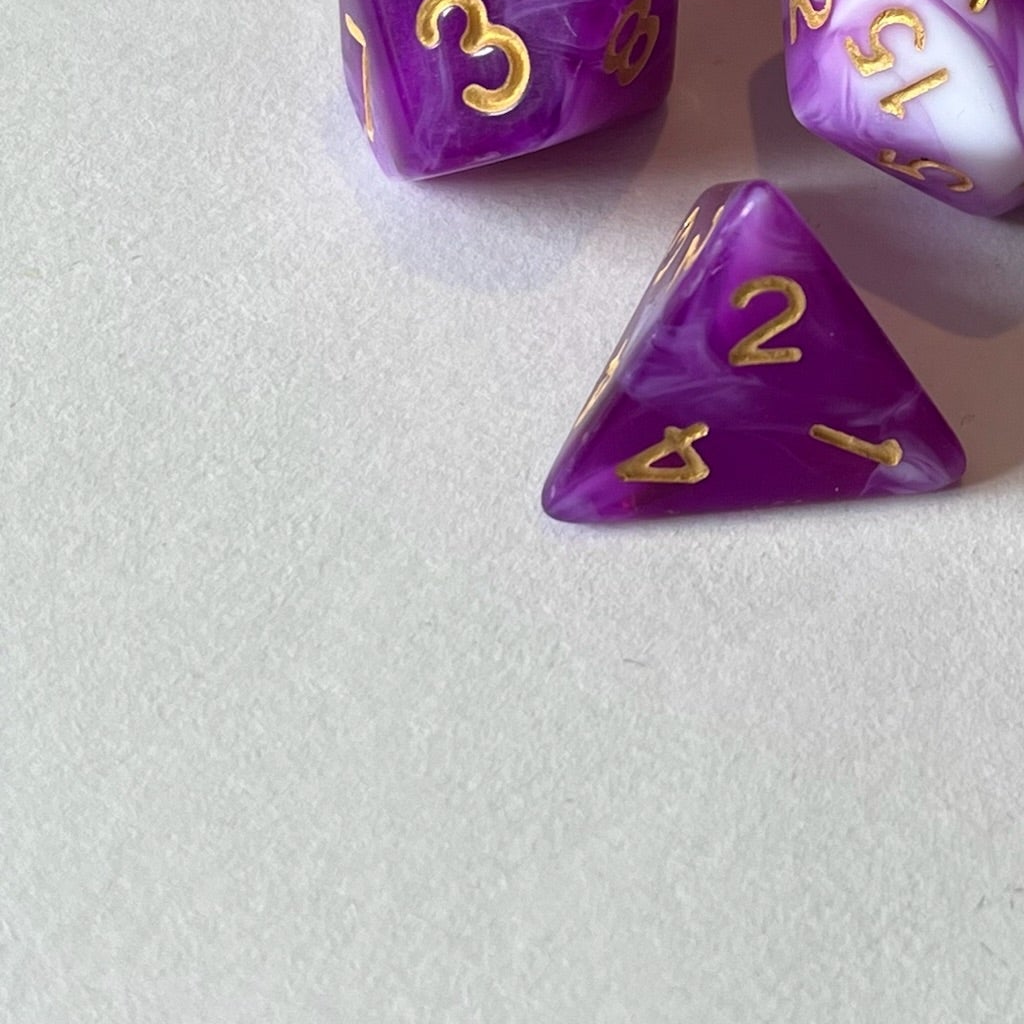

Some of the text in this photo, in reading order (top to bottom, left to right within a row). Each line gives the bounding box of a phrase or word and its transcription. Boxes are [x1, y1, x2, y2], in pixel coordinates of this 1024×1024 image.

[845, 7, 949, 119] 15
[728, 276, 807, 367] 2
[615, 422, 710, 484] 4
[809, 423, 903, 466] 1
